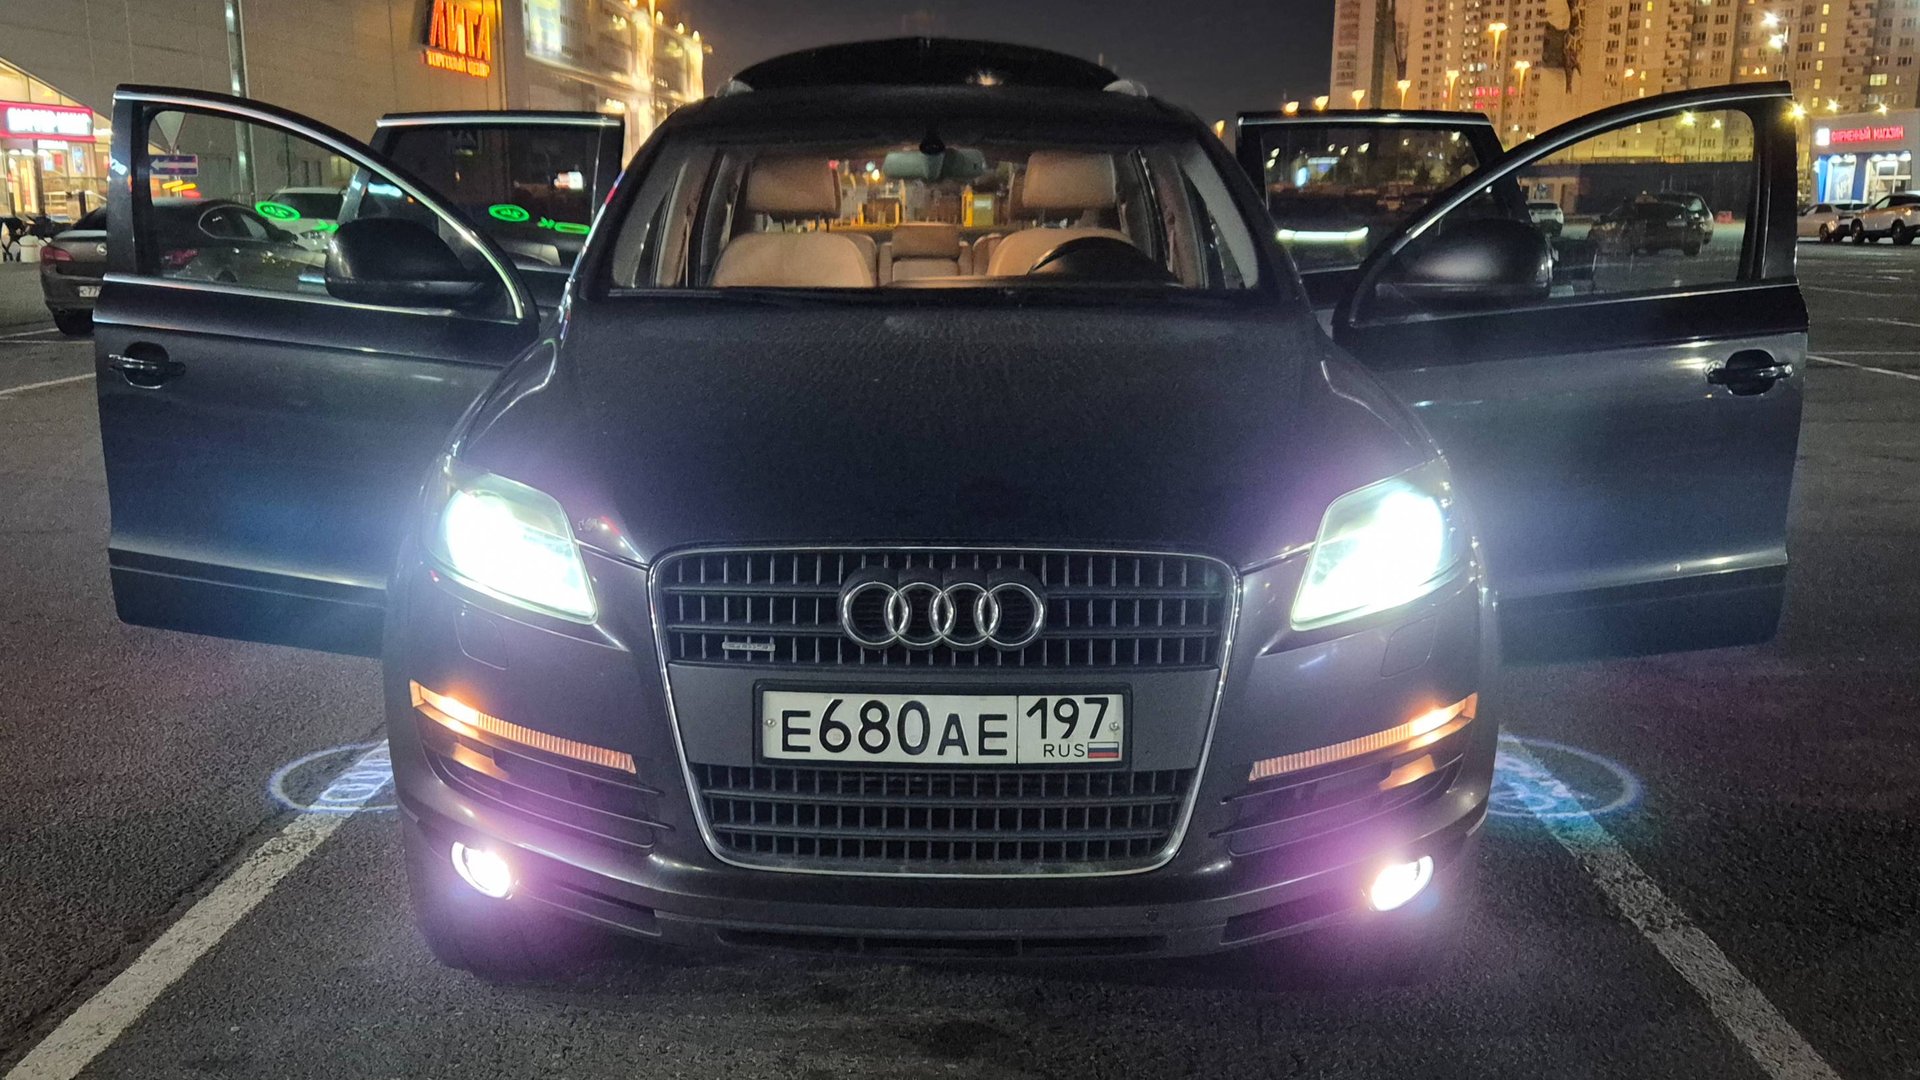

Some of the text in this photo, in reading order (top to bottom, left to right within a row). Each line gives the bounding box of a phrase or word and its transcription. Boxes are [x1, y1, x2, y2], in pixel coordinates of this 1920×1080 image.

[430, 0, 491, 61] ЛИГА
[1026, 697, 1110, 740] 197
[1043, 744, 1085, 757] RUS
